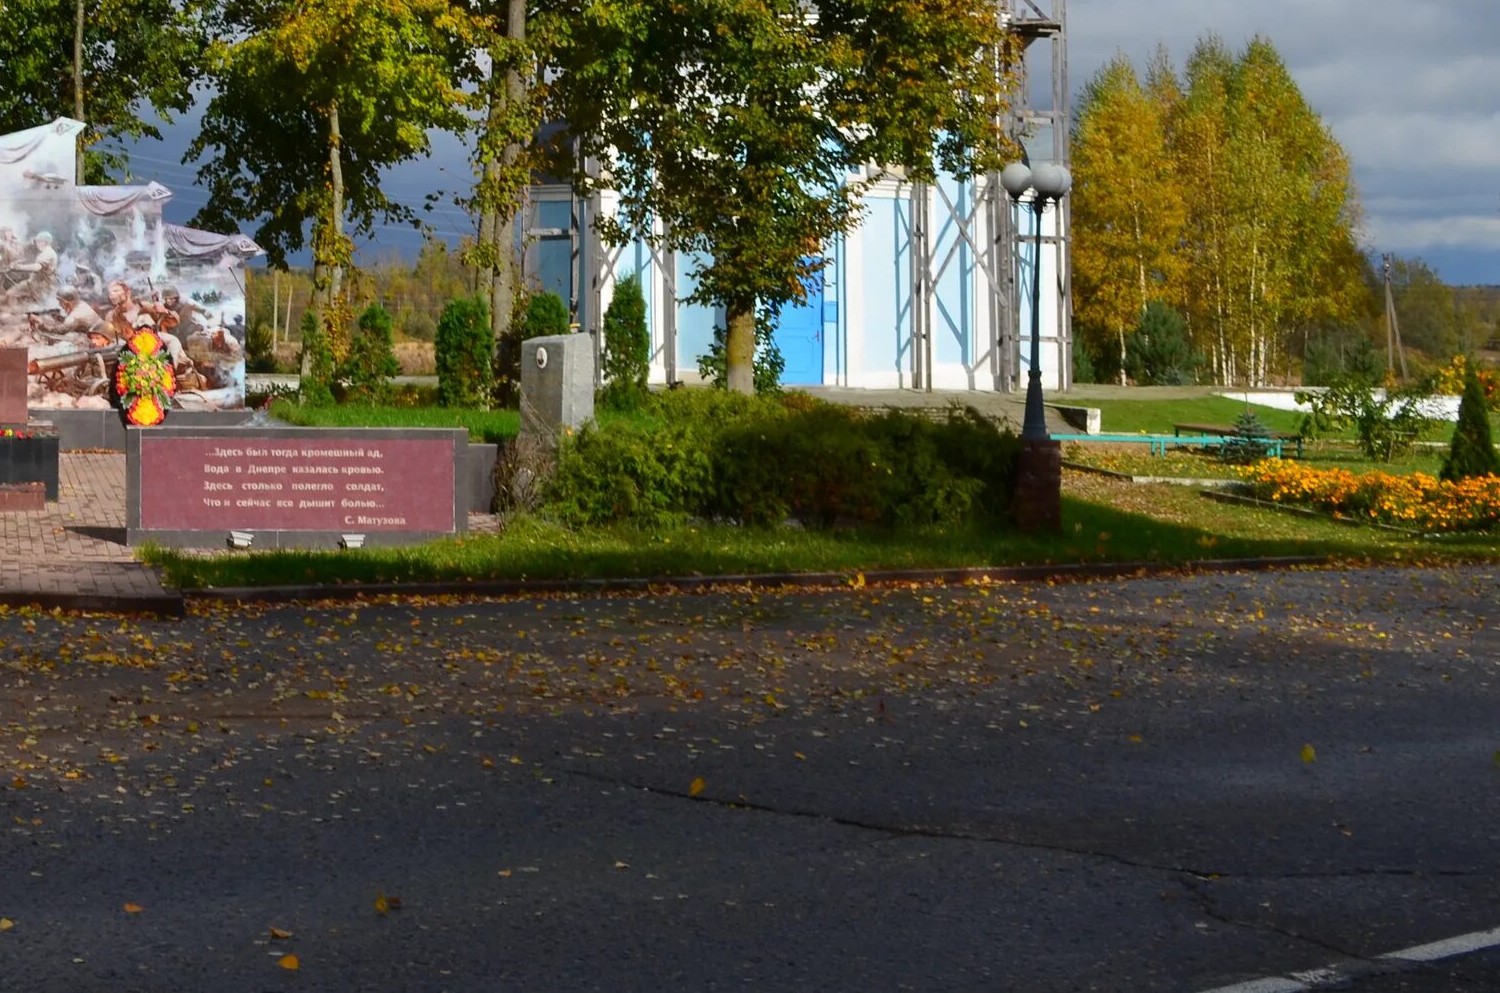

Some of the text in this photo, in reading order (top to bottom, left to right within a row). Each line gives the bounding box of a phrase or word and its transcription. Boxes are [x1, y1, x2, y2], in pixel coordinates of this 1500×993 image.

[246, 447, 268, 457] был
[270, 449, 298, 458] тогда
[301, 448, 365, 459] кромешный
[204, 464, 384, 475] Вода в Днепре казалась кровью.
[203, 481, 385, 492] Здесь столько полегло солдат,
[202, 497, 221, 507] Что
[223, 499, 230, 507] и
[236, 497, 271, 507] сейчас
[299, 499, 335, 509] дышит
[344, 514, 406, 526] С. Матузова
